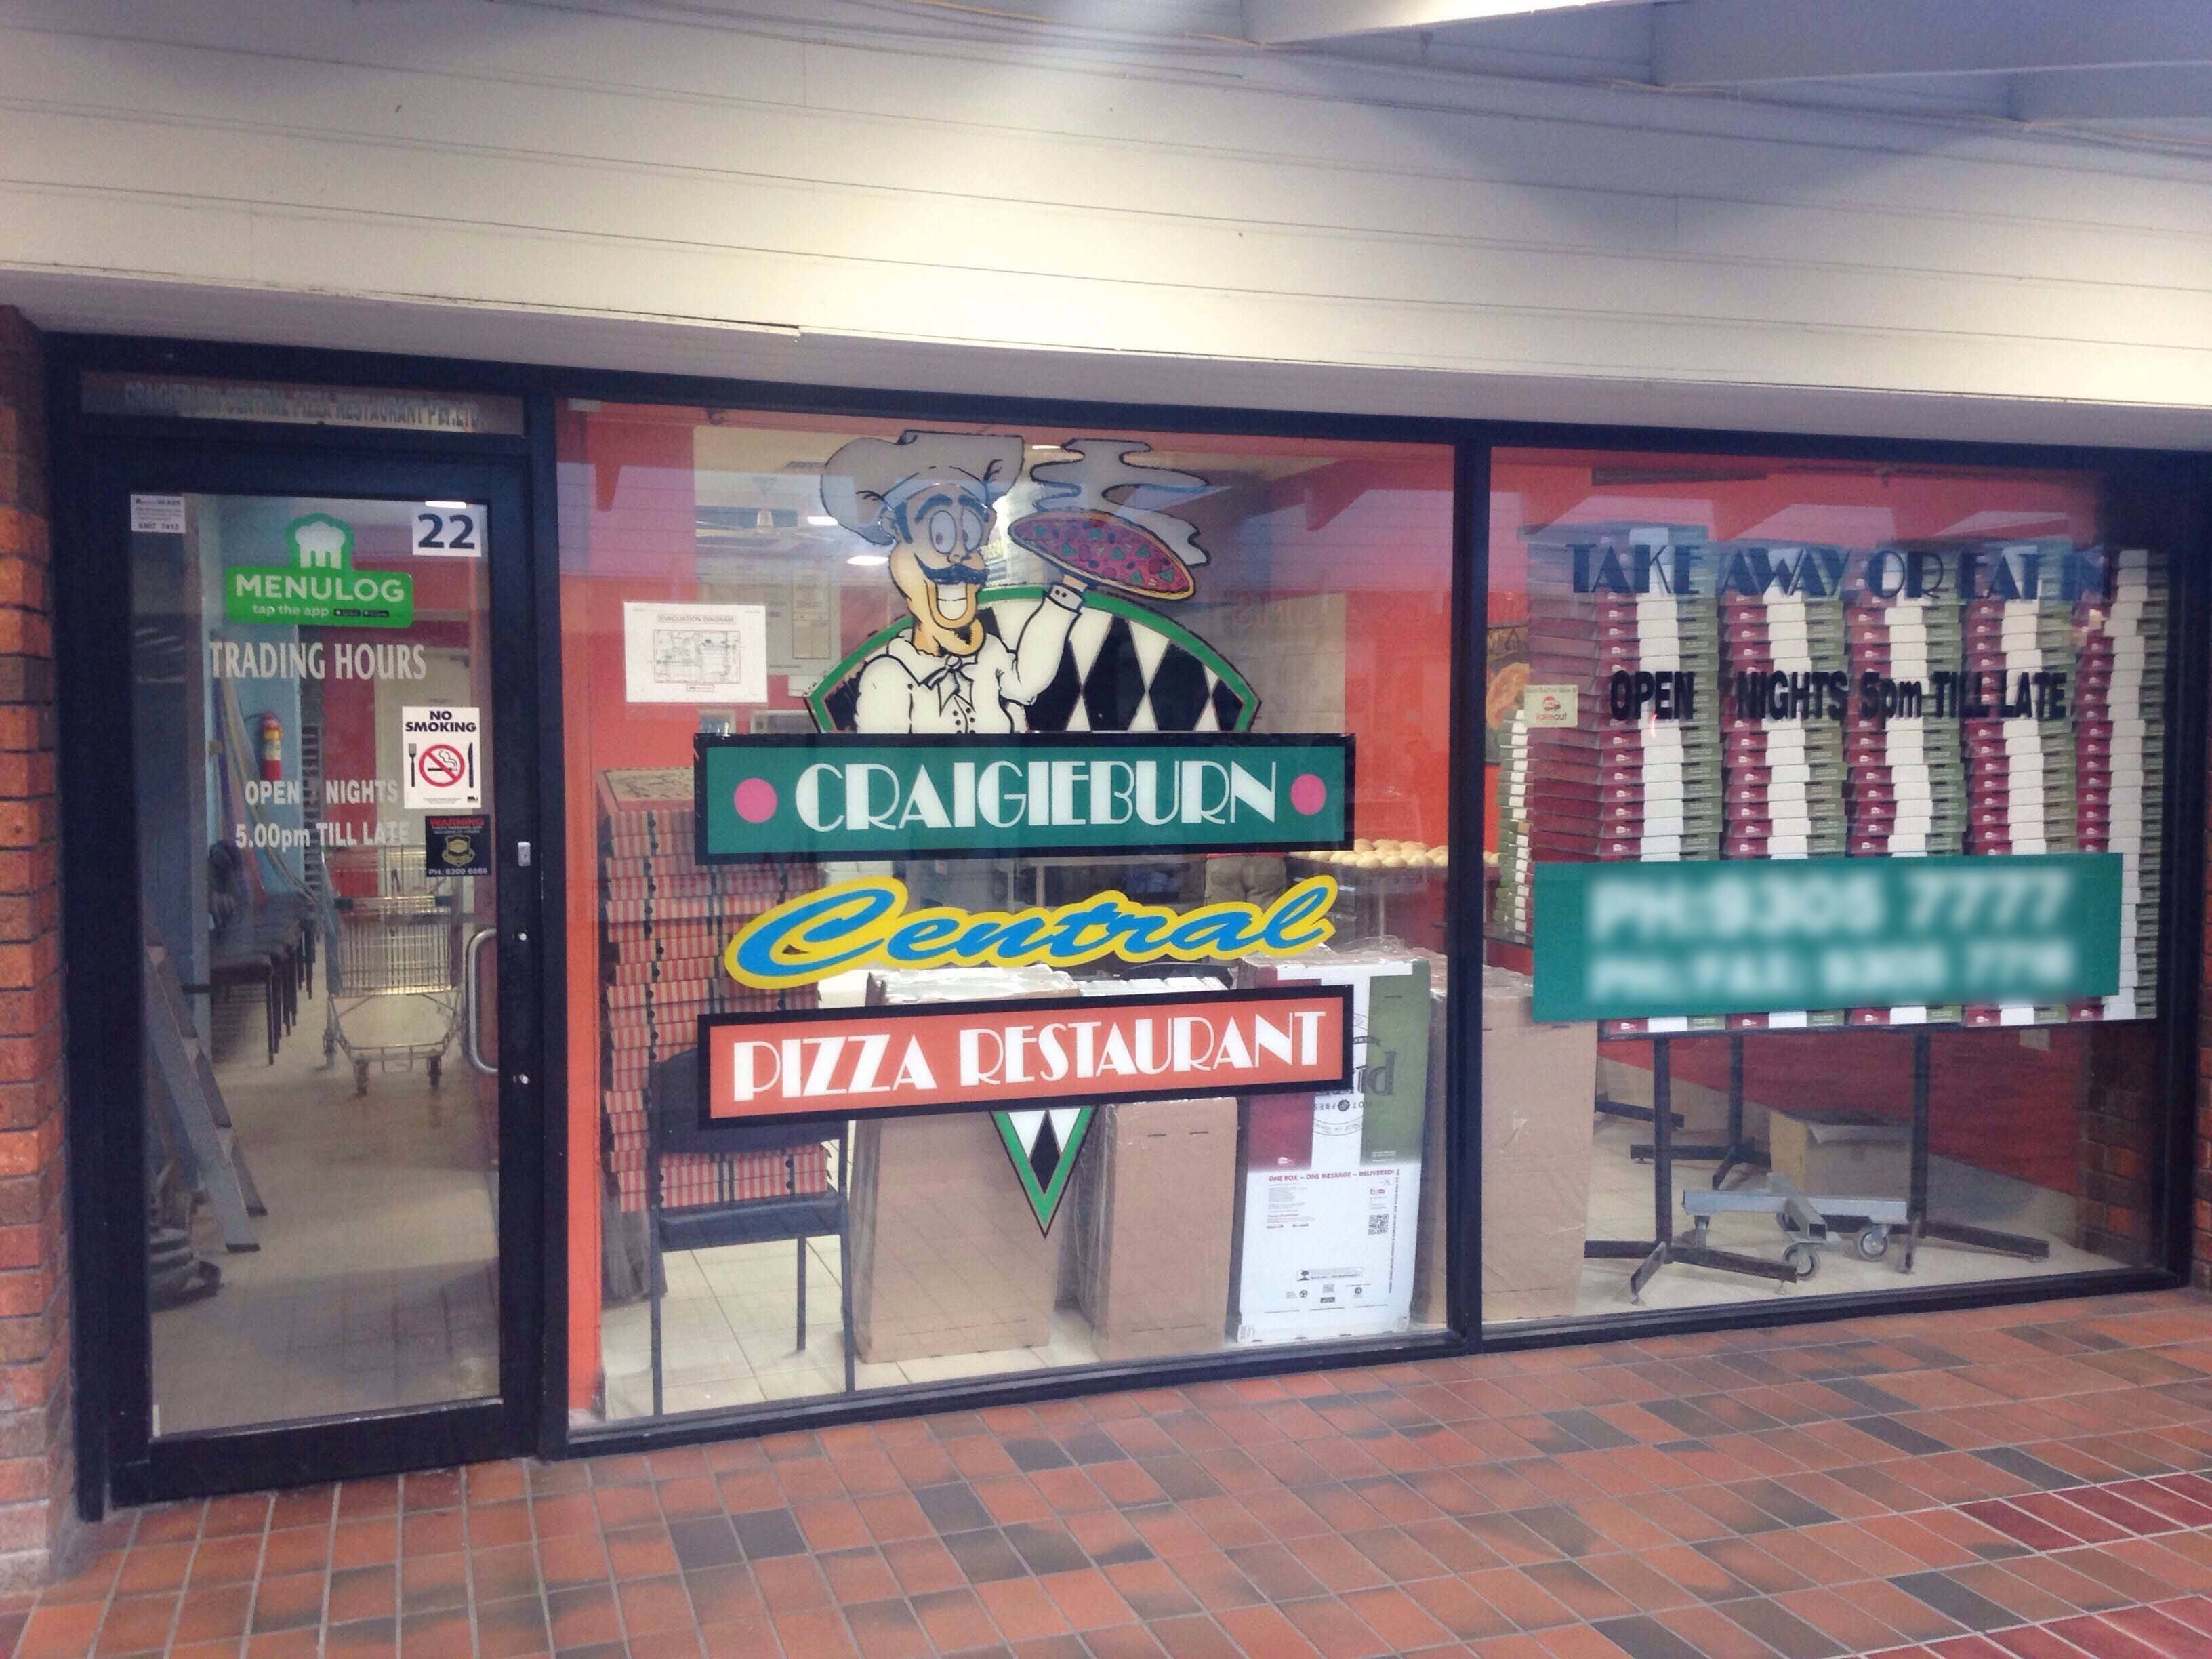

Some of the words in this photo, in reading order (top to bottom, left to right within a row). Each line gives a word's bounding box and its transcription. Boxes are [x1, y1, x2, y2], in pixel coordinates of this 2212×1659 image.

[418, 513, 475, 550] 22
[235, 573, 405, 602] MENULOG
[1567, 544, 1702, 594] TAKE
[1720, 546, 1851, 597] AWAY
[1868, 550, 1949, 599] OR
[1959, 550, 2049, 600] EAT
[2063, 551, 2111, 600] IN
[252, 603, 276, 617] tap
[279, 605, 300, 616] the
[304, 606, 330, 618] app
[659, 615, 701, 623] EVACUATION
[703, 615, 735, 623] DIAGRAM
[210, 640, 325, 679] TRADING
[334, 643, 427, 680] HOURS
[1610, 670, 1694, 720] OPEN
[1736, 670, 1849, 720] NIGHTS
[1861, 672, 1923, 727] 5pm
[1933, 671, 1990, 718] TILL
[2000, 671, 2067, 718] LATE
[405, 721, 477, 732] SMOKING
[429, 710, 453, 720] NO
[245, 779, 300, 805] OPEN
[325, 779, 398, 805] NIGHTS
[795, 760, 1277, 833] CRAIGIEBURN
[234, 822, 310, 852] 5.00pm
[316, 821, 357, 846] TILL
[362, 821, 410, 846] LATE
[430, 817, 485, 826] WARNING
[725, 876, 1337, 988] Central
[732, 1033, 939, 1102] PIZZA
[960, 1010, 1326, 1087] RESTAURANT
